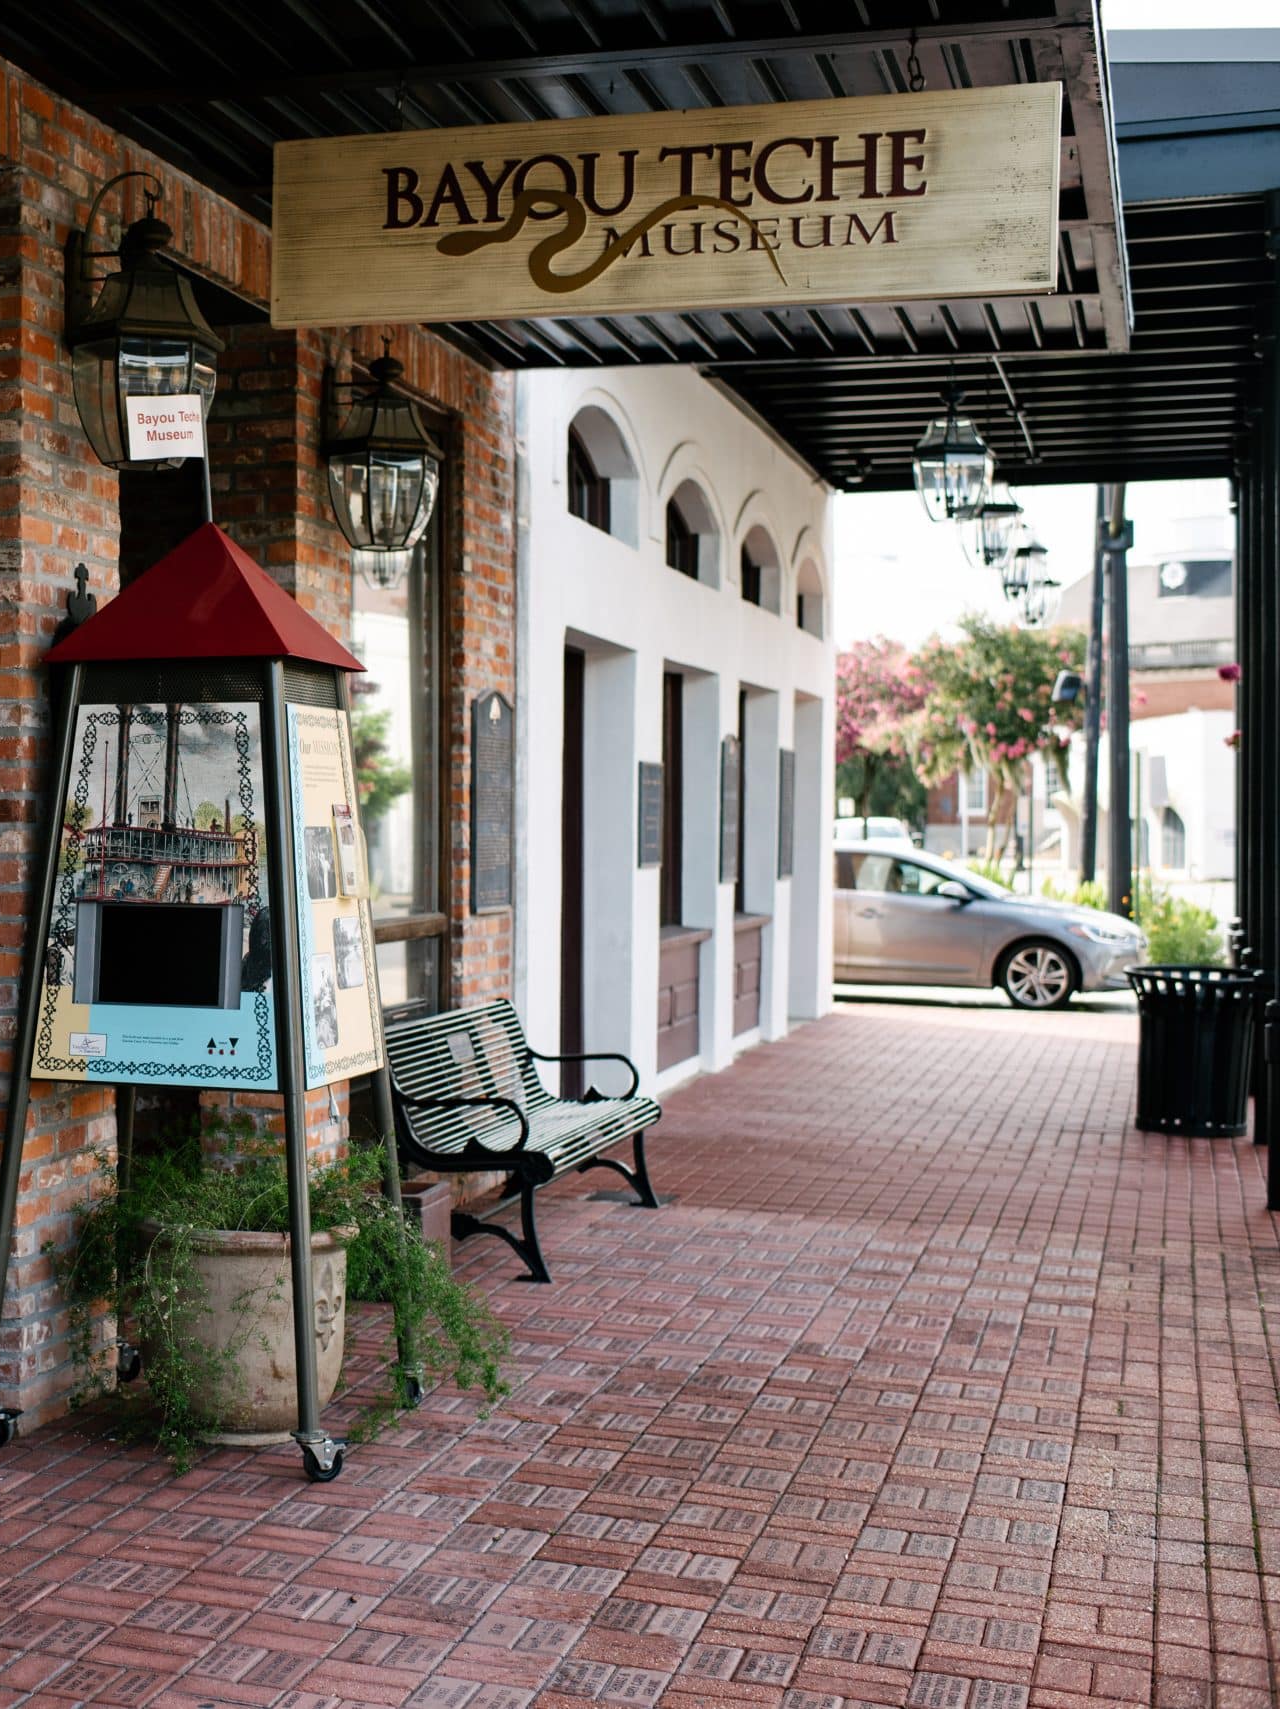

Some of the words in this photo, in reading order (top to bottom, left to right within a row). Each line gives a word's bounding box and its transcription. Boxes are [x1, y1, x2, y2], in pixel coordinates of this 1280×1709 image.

[381, 148, 637, 230] BAYOU
[658, 128, 928, 209] TECHE
[603, 210, 900, 259] MUSEUM
[137, 413, 175, 426] Bayou
[147, 430, 193, 441] Museum
